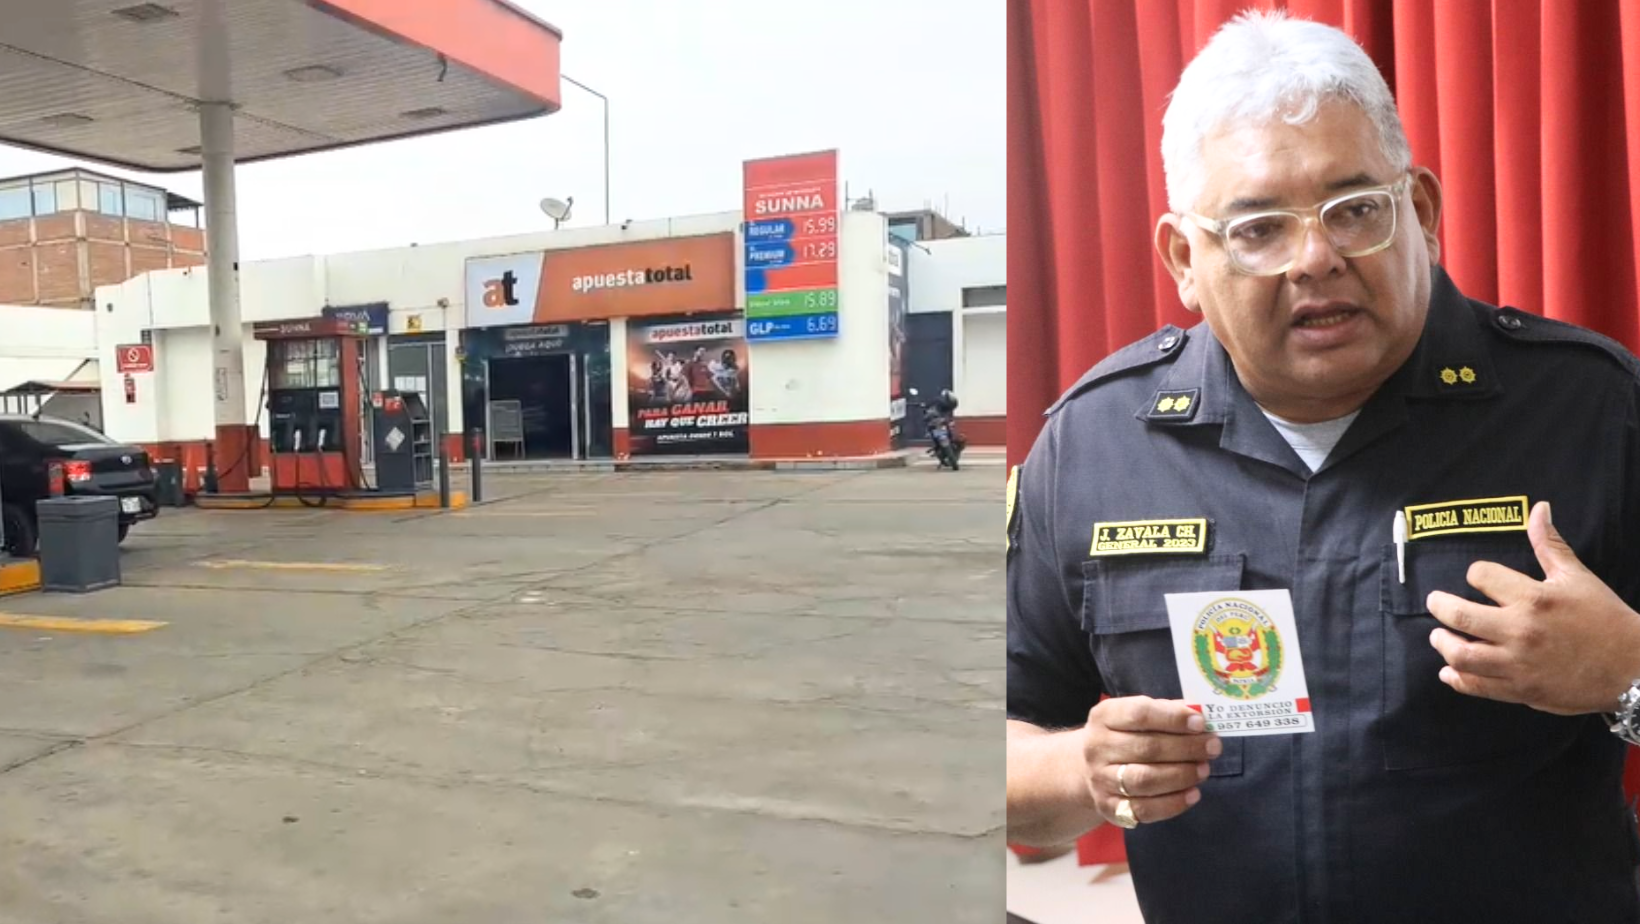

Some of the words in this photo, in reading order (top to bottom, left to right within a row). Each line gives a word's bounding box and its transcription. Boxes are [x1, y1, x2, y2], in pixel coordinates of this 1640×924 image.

[755, 195, 823, 213] SUNNA
[802, 216, 836, 235] 15.99
[572, 264, 692, 292] apuestatotal
[482, 270, 519, 307] at
[651, 322, 733, 340] apuestatotal
[749, 321, 774, 335] GLP
[806, 316, 837, 333] 6.69
[671, 401, 729, 415] GANAR
[644, 418, 669, 428] HAY
[670, 416, 695, 427] QUE
[696, 412, 748, 427] CREER
[1414, 510, 1459, 531] POLICIA
[1462, 506, 1522, 525] NACIONAL
[1100, 528, 1110, 541] J.
[1115, 525, 1171, 540] ZAVALA
[1097, 539, 1157, 550] GENERAL
[1162, 538, 1197, 548] 2023
[1225, 601, 1269, 626] NACIONAL
[1229, 701, 1292, 712] DENUNCIO
[1217, 722, 1241, 730] 957
[1246, 720, 1271, 728] 649
[1274, 718, 1300, 726] 338
